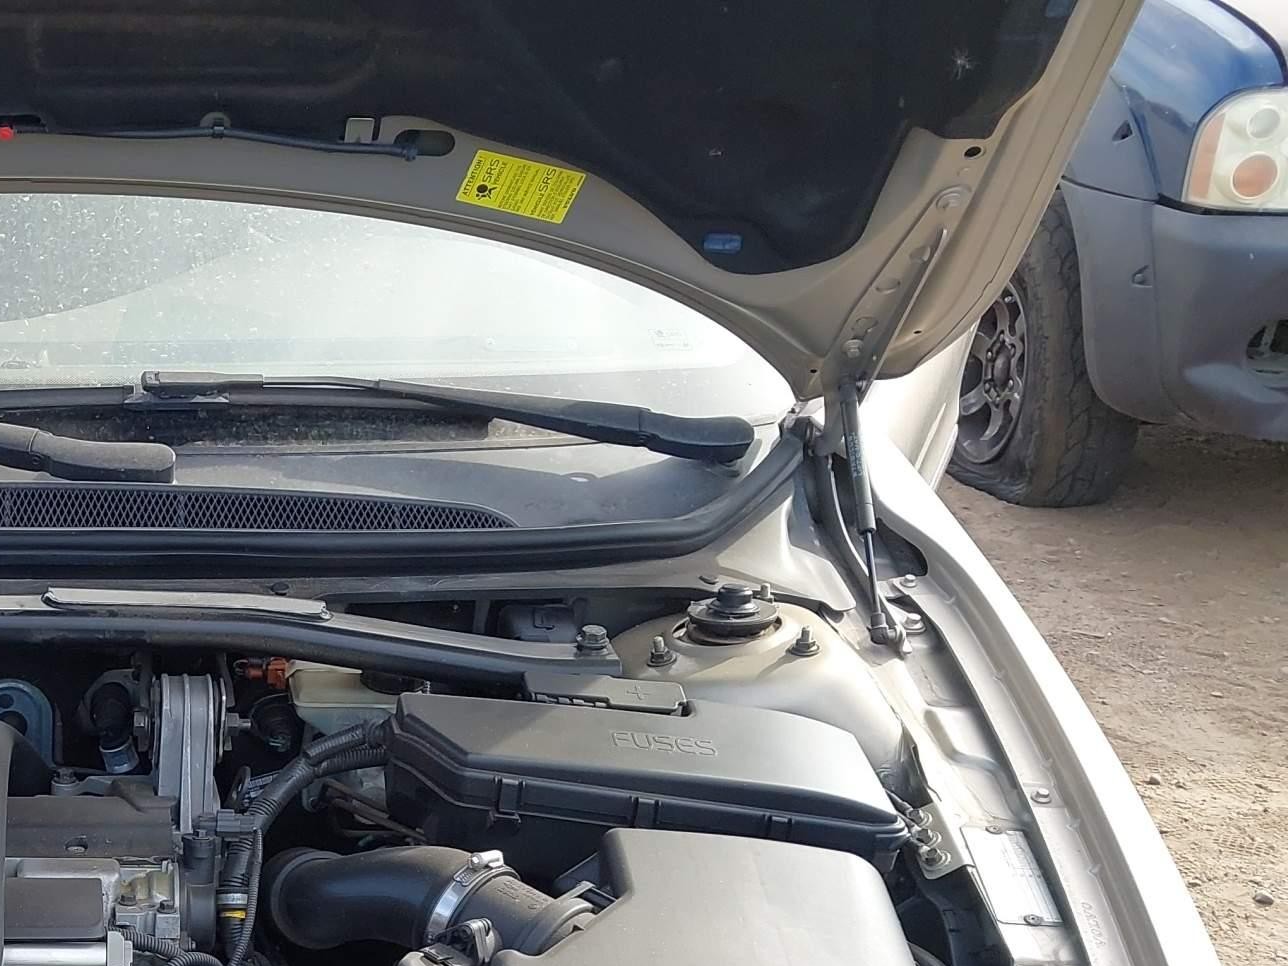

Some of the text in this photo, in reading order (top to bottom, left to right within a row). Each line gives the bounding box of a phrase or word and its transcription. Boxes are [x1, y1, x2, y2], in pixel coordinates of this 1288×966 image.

[462, 159, 483, 196] ATTENTION
[482, 159, 500, 183] SRS
[538, 168, 557, 193] SRS
[611, 731, 718, 756] FUSES
